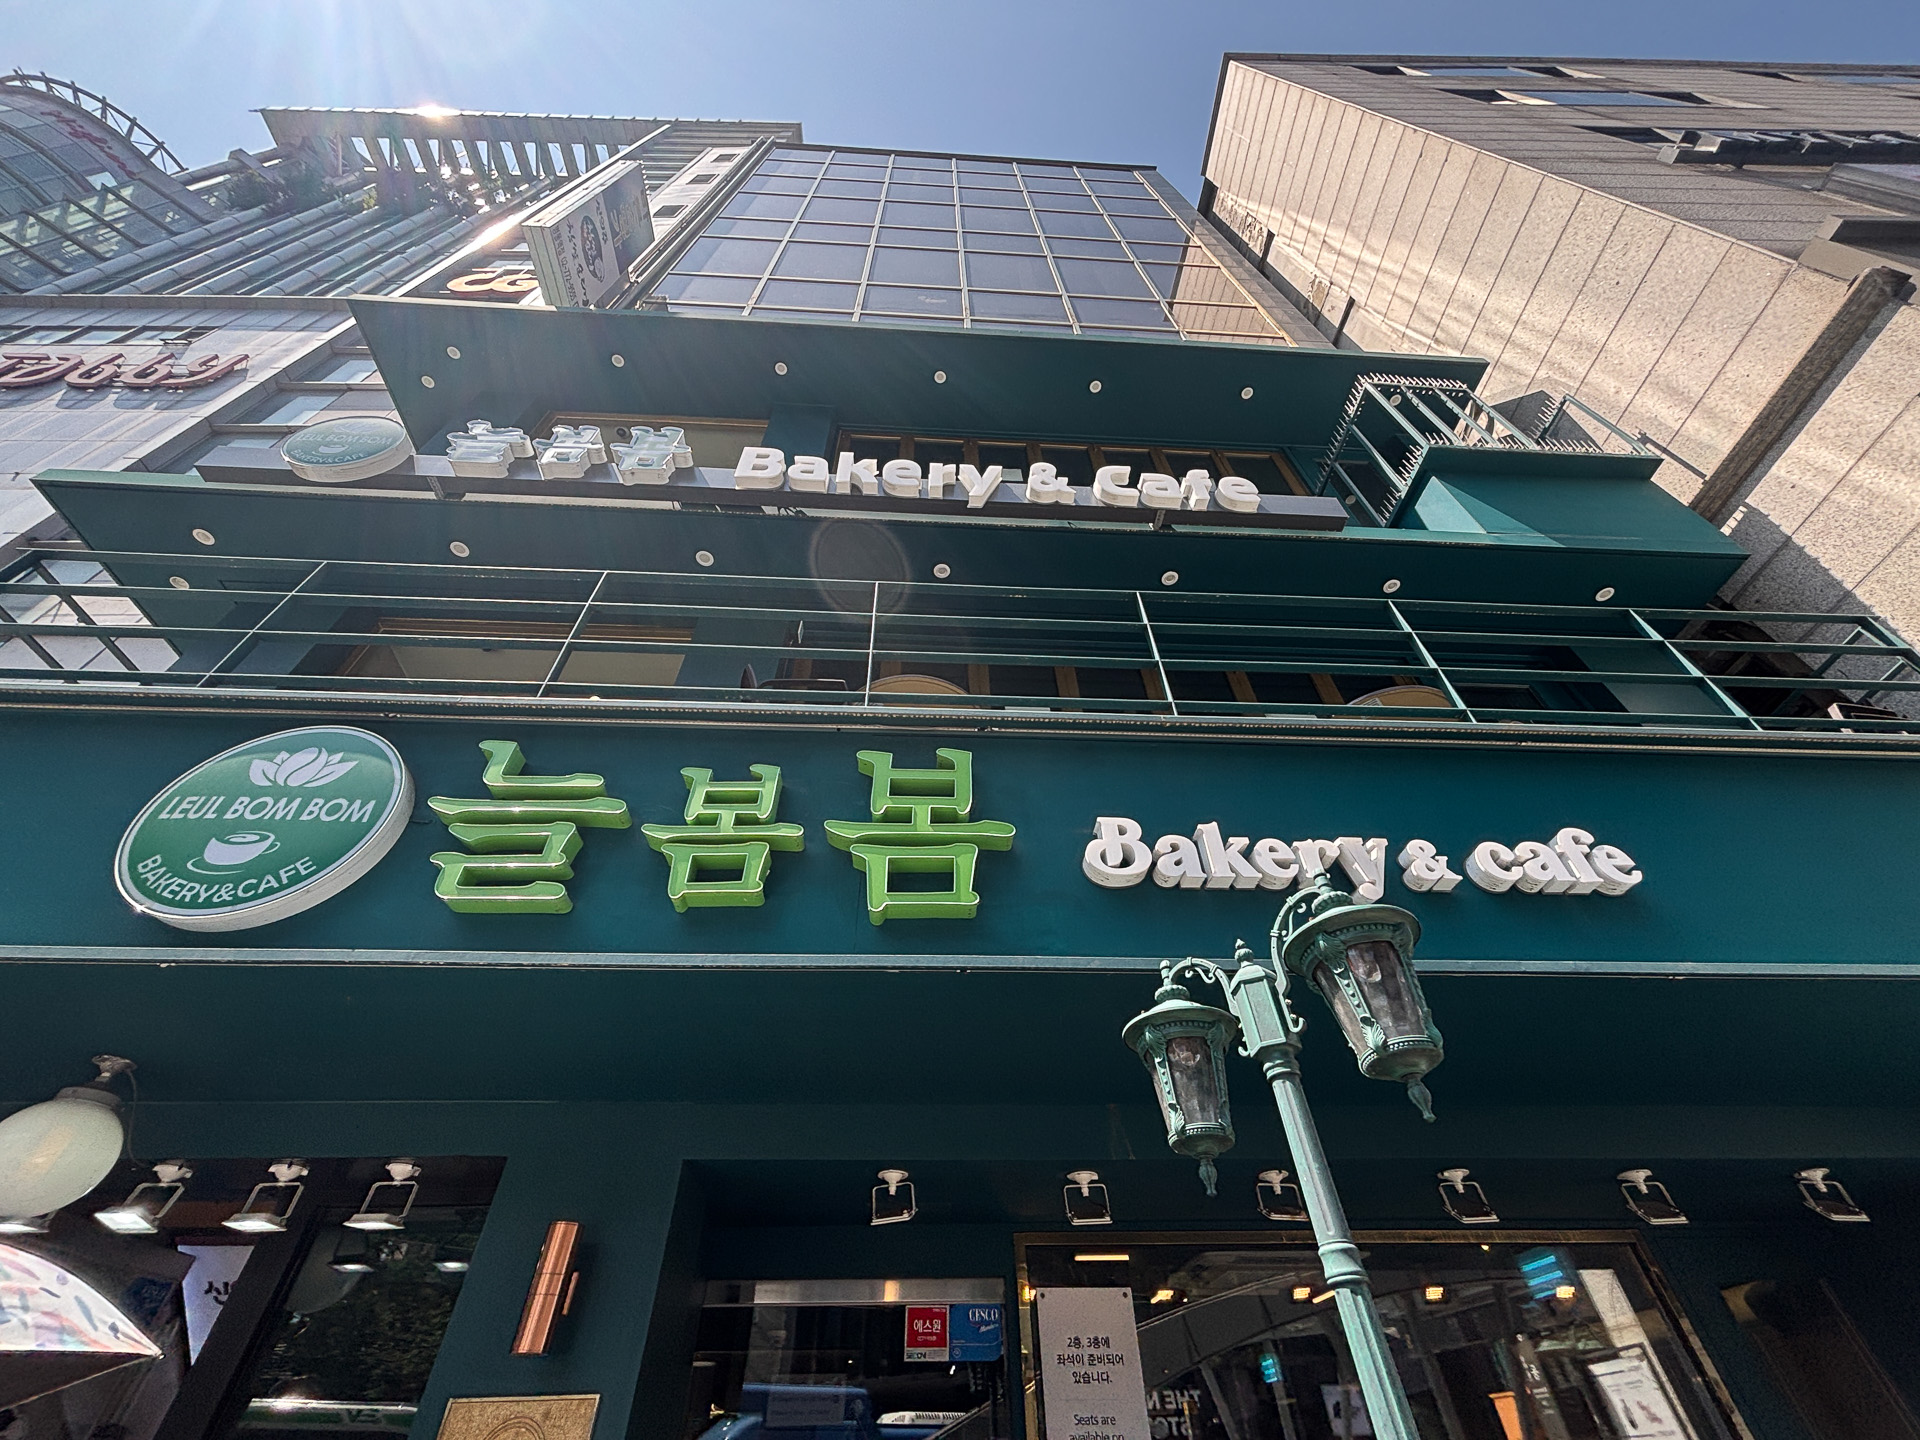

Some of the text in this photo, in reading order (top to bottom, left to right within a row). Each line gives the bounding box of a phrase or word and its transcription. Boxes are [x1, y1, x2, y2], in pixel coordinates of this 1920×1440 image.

[446, 272, 541, 293] CG
[733, 446, 1002, 508] Bakery
[1026, 461, 1077, 506] &
[157, 796, 376, 823] LEUL BOM BOM
[427, 739, 1017, 926] 늘봄봄
[1082, 816, 1389, 903] Bakery
[1397, 838, 1463, 893] &
[967, 1308, 999, 1321] CESCO
[913, 1319, 941, 1333] 에스원
[1067, 1336, 1111, 1350] 2층, 3층에
[1056, 1353, 1124, 1366] 좌석이 준비되어
[1072, 1371, 1113, 1384] 있습니다.
[1073, 1414, 1117, 1426] Seats are
